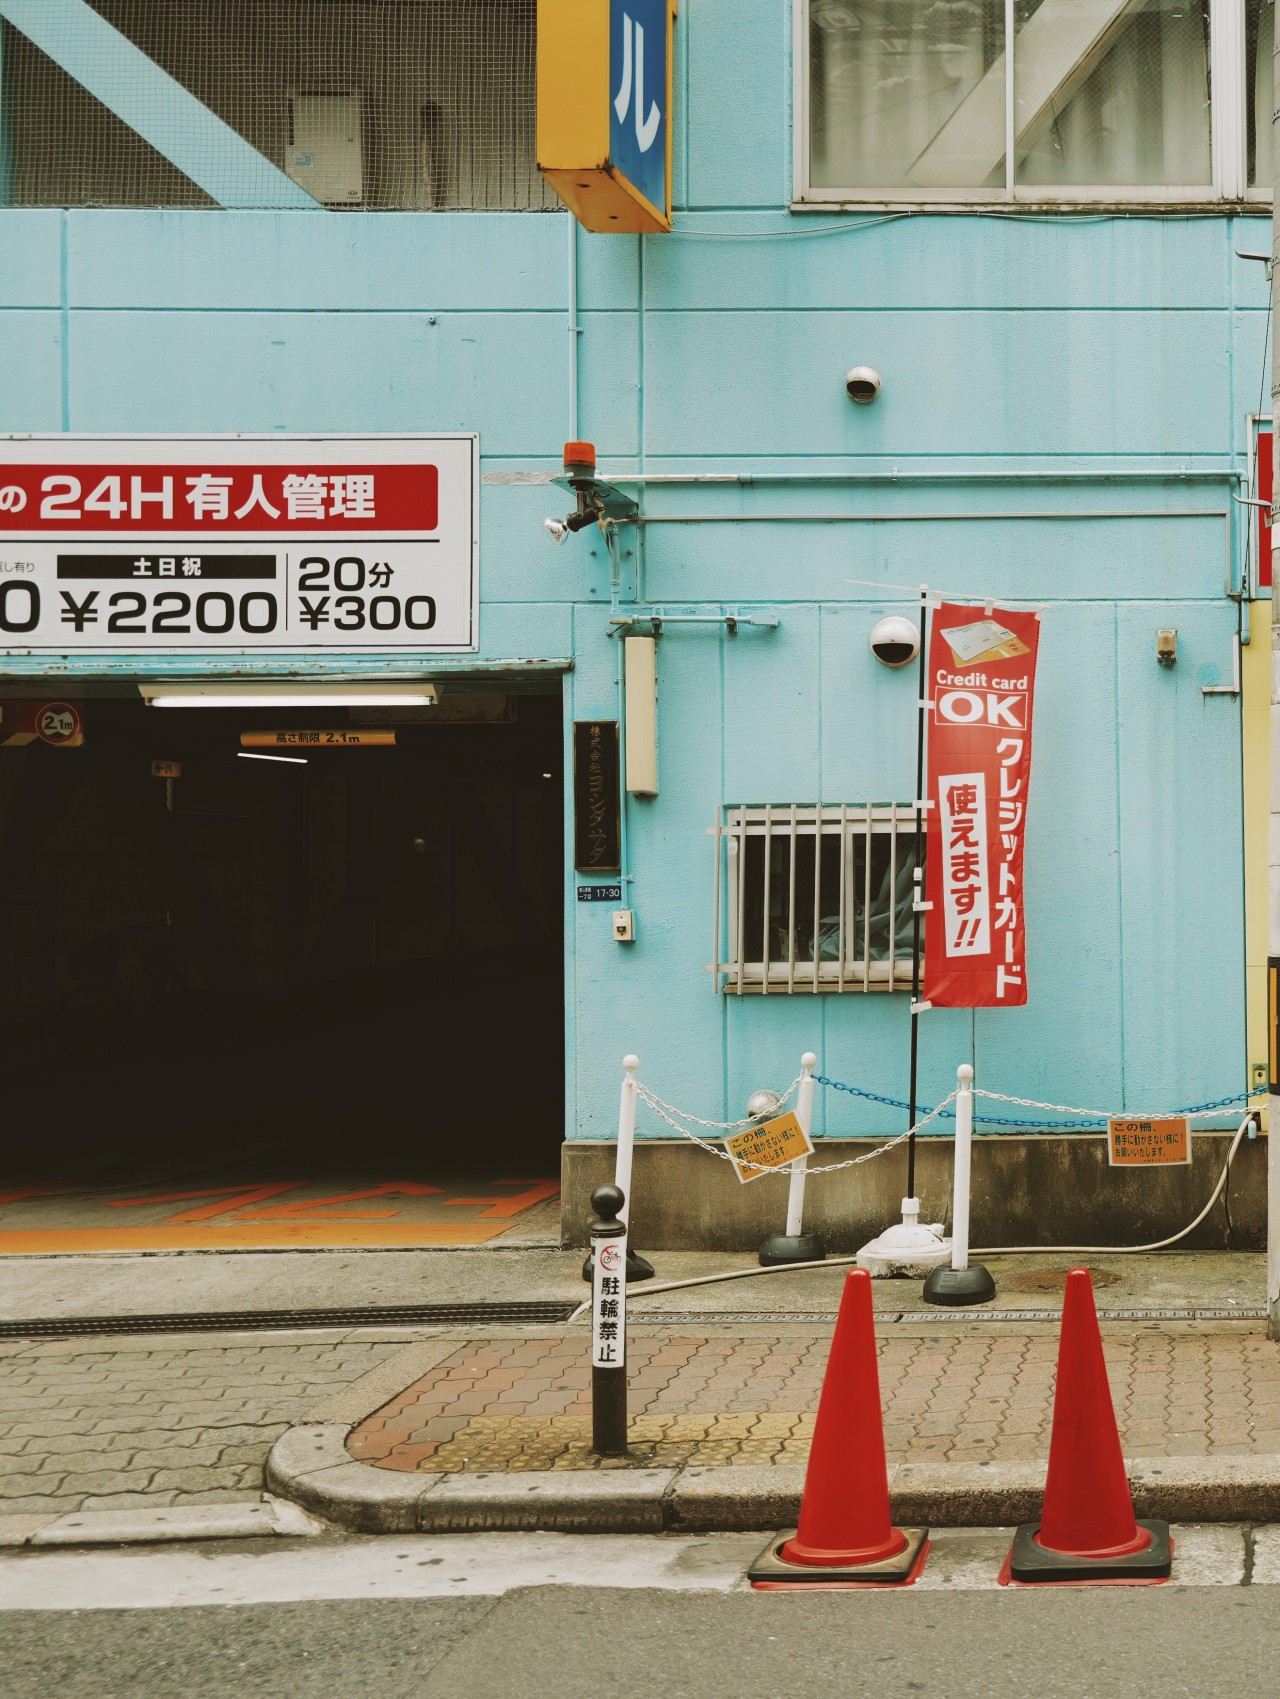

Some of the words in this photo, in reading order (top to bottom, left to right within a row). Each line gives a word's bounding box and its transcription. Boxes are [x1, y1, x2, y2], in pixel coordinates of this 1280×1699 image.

[614, 12, 660, 153] ル
[40, 475, 173, 519] 24H
[185, 473, 376, 520] 有人管理
[133, 558, 202, 577] 土日祝
[298, 556, 394, 592] 20分
[59, 590, 278, 634] ¥2200
[299, 595, 436, 631] ¥300
[936, 669, 987, 687] Credit
[991, 676, 1028, 690] card
[939, 691, 1023, 728] OK
[276, 731, 320, 744] 高さ制限
[326, 732, 360, 744] 2.1m
[994, 737, 1024, 998] クレジットカード
[596, 888, 620, 898] 17-30
[598, 1276, 620, 1362] 駐輪禁止
